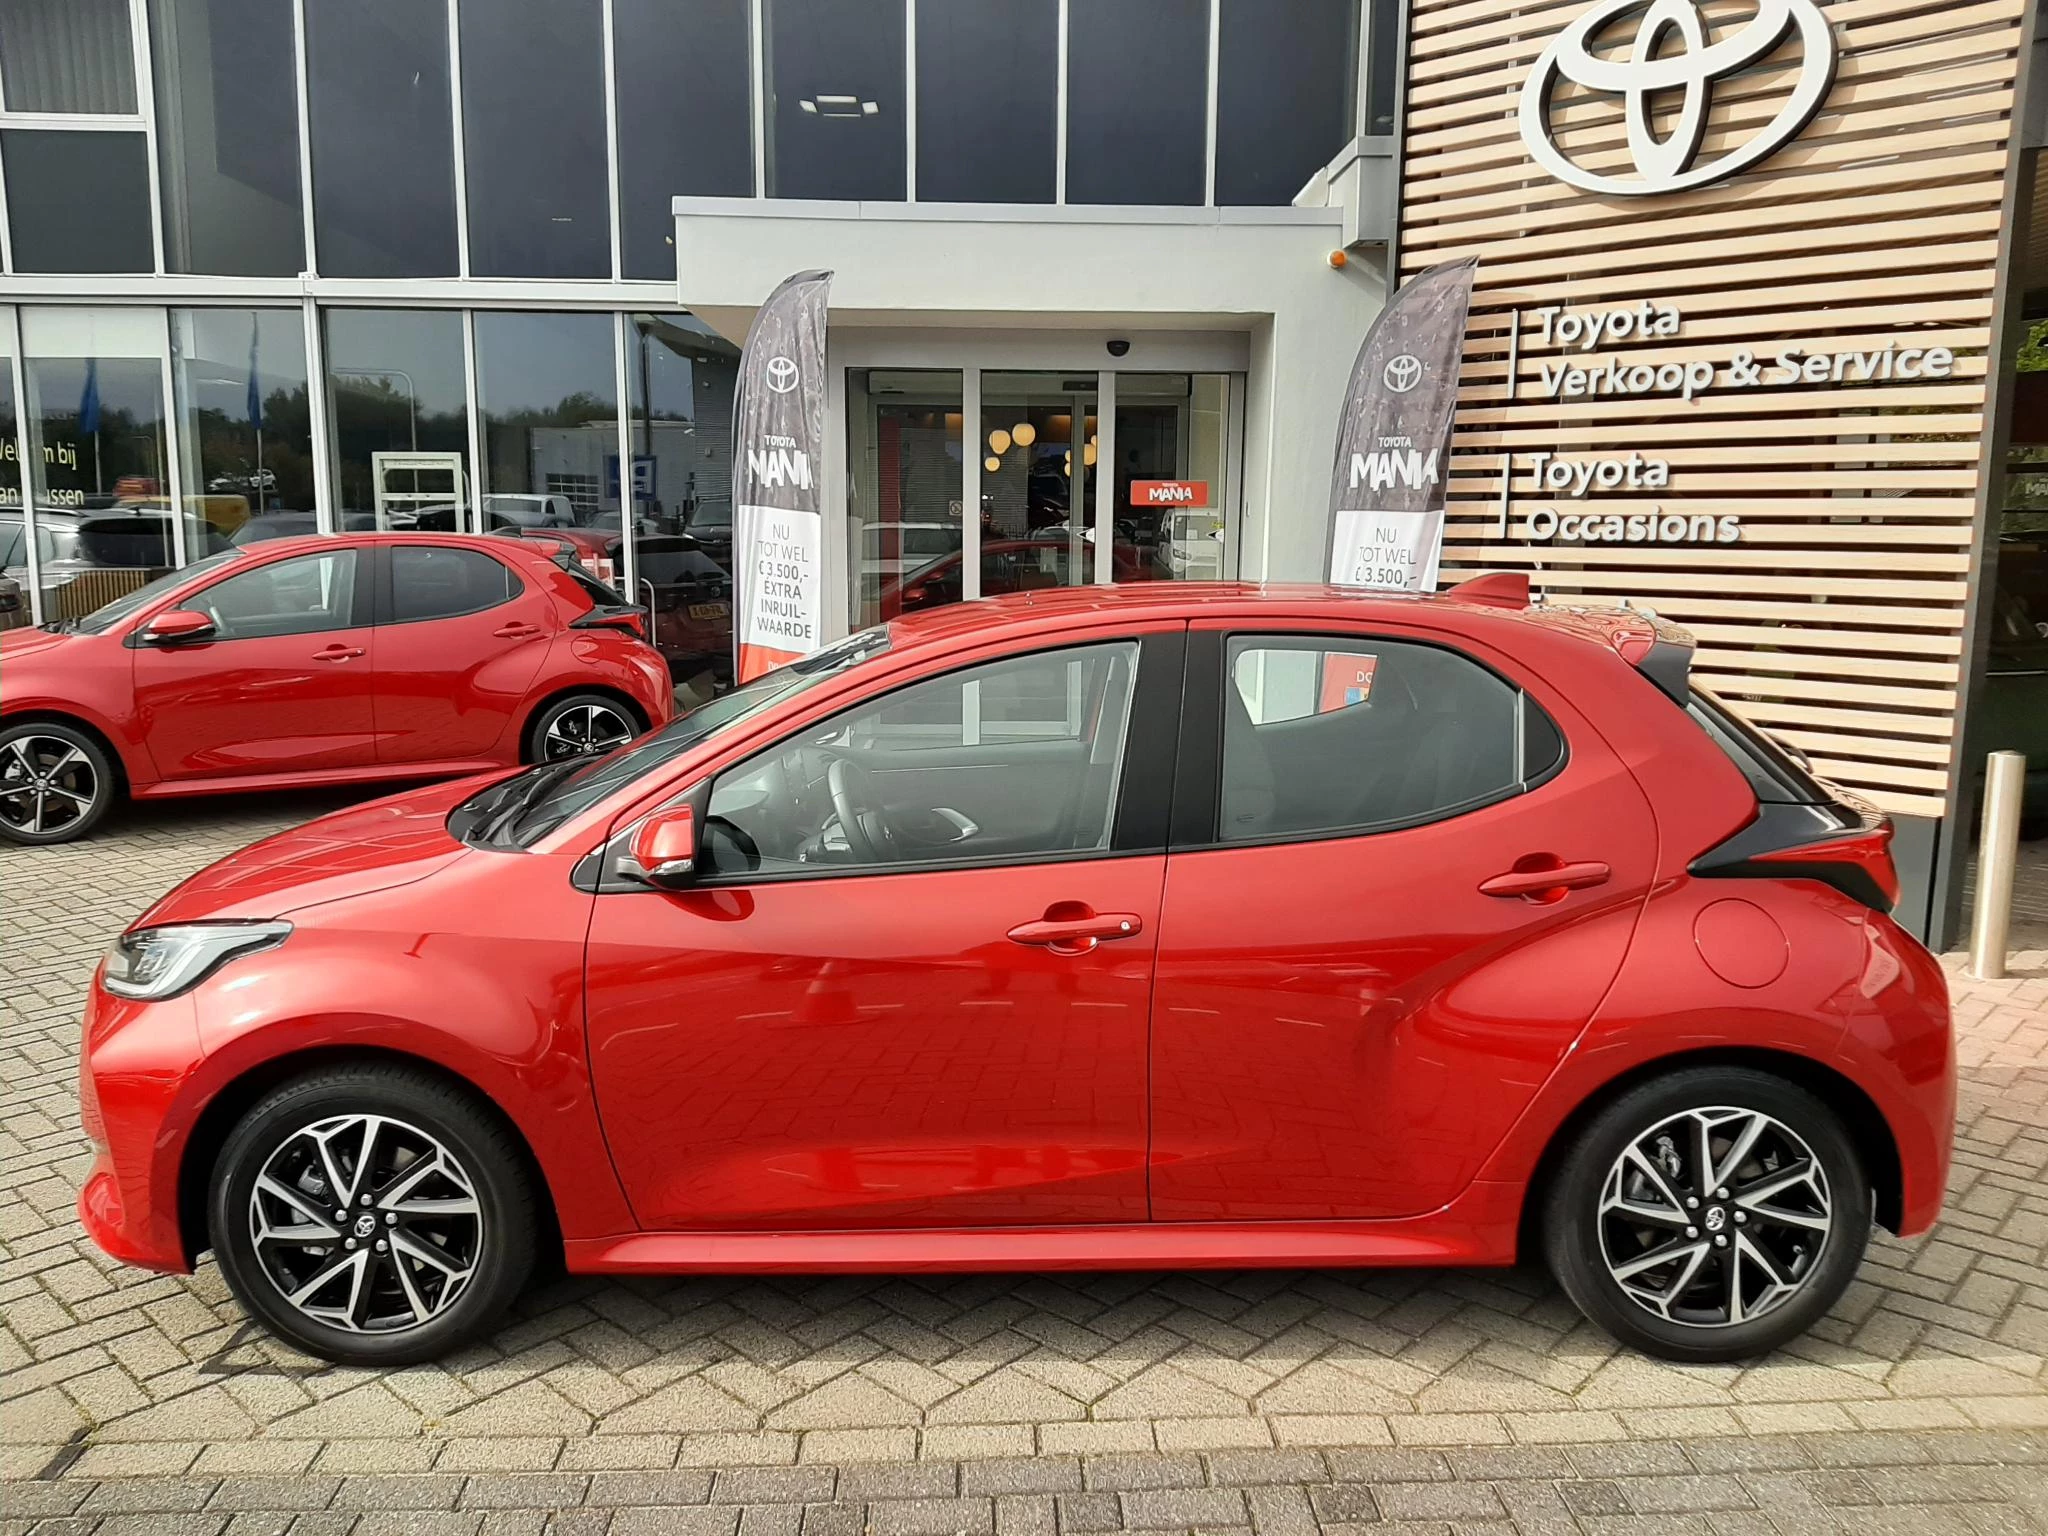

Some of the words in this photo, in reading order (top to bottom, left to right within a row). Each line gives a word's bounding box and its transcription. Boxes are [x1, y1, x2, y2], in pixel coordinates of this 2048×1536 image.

[1537, 300, 1681, 350] Toyota
[1539, 356, 1714, 401] Verkoop
[1730, 349, 1762, 387] &
[1775, 340, 1954, 385] Service
[1378, 436, 1412, 448] TOYOTA
[57, 441, 77, 471] bij
[1350, 447, 1440, 492] MANIA
[1527, 451, 1670, 497] Toyota
[1149, 486, 1193, 502] MANIA
[772, 523, 790, 541] NU
[1375, 527, 1397, 543] NU
[1526, 505, 1741, 542] Occasions
[757, 540, 779, 558] TOT
[781, 545, 809, 563] WEL
[1385, 547, 1417, 566] WEL
[761, 599, 808, 619] INRUIL-
[757, 616, 812, 639] WAARDE
